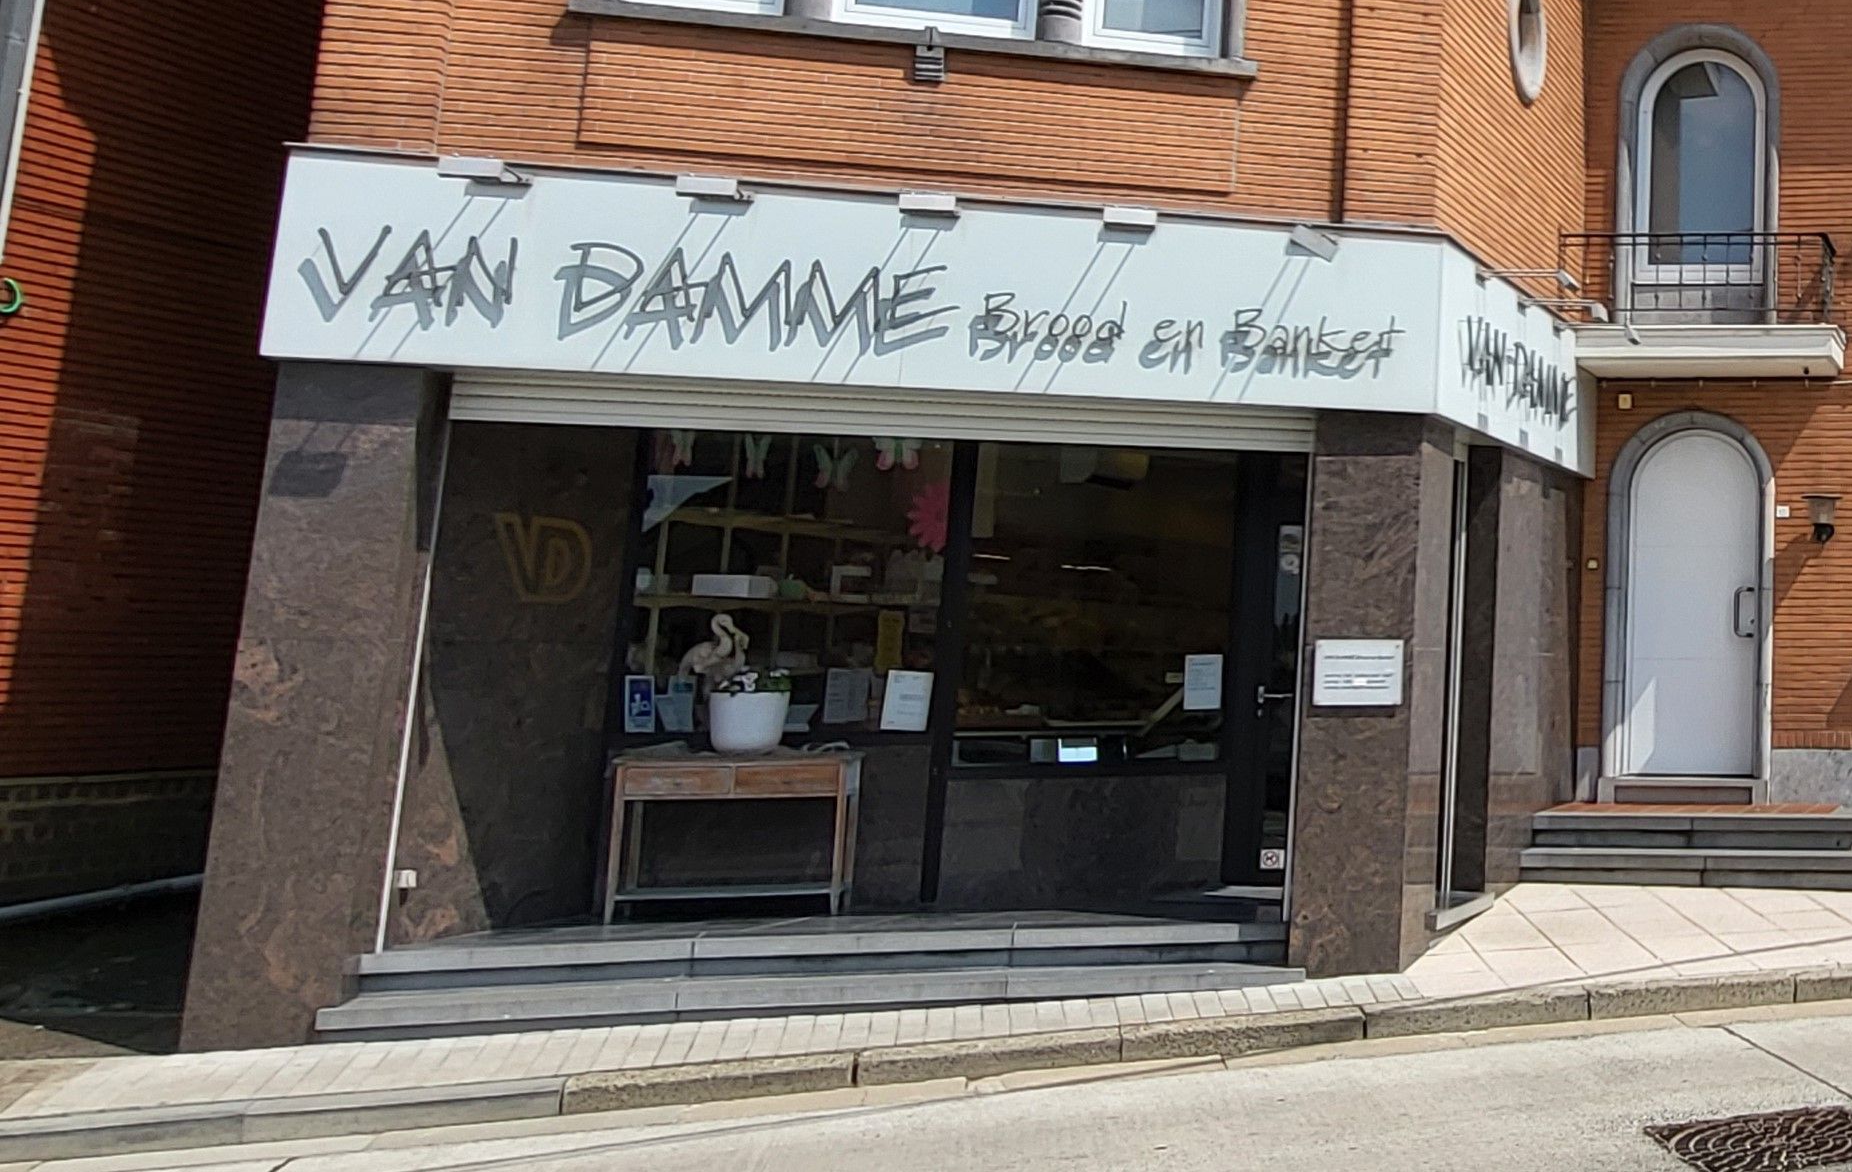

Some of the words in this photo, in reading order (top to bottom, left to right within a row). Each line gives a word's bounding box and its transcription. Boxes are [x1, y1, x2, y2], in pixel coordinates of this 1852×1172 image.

[318, 225, 518, 307] VAN
[569, 242, 960, 324] DAMME
[984, 292, 1128, 341] Brood
[1153, 319, 1204, 349] en
[1234, 308, 1406, 356] Banket
[1466, 315, 1507, 386] VAN
